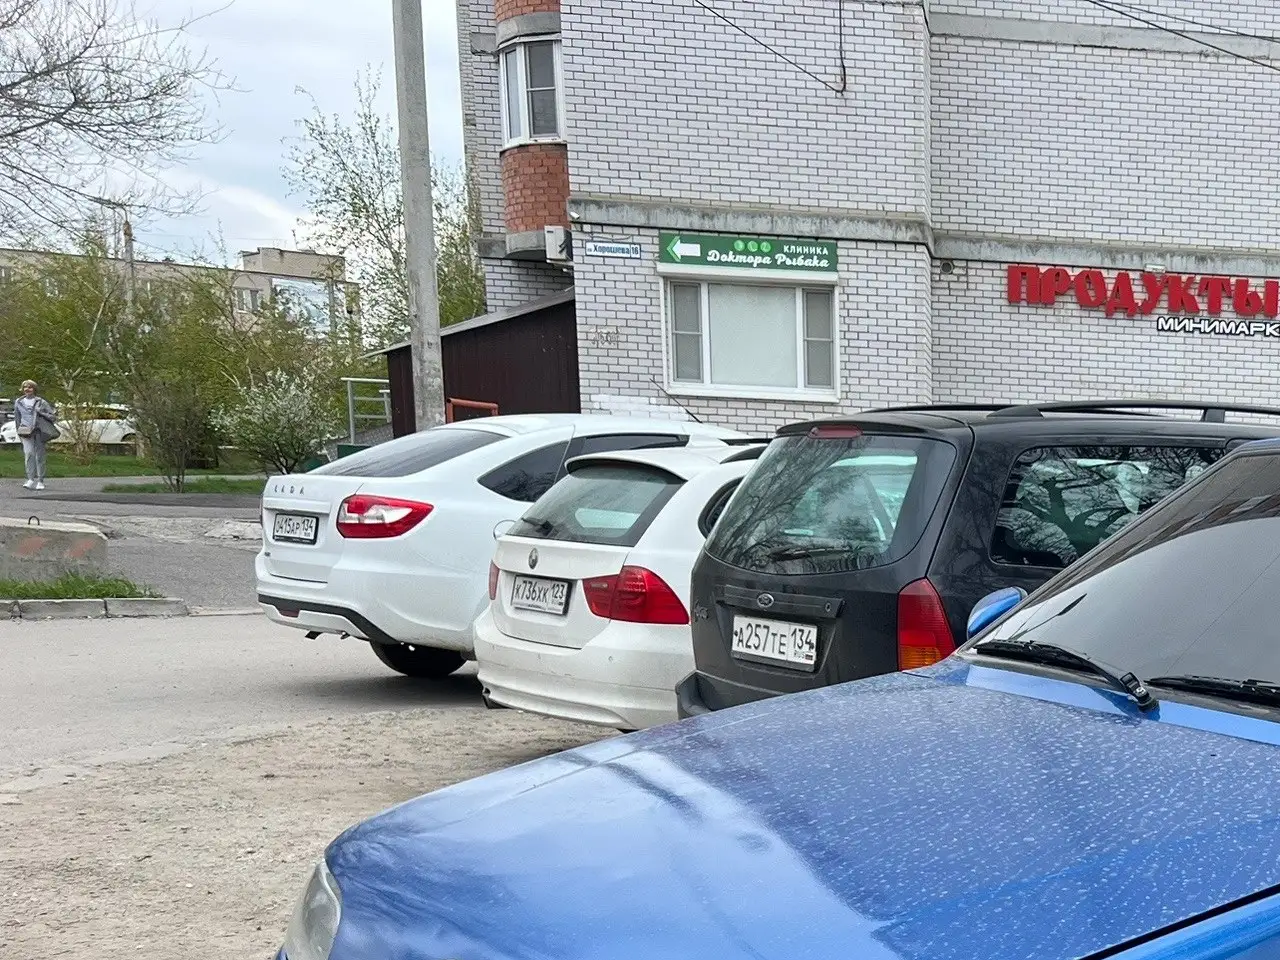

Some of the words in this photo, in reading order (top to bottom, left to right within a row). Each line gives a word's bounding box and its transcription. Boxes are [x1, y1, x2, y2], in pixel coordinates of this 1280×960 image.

[593, 244, 630, 254] Хорошева
[783, 244, 829, 256] КЛИНИКА
[707, 249, 773, 267] Доктора
[774, 252, 830, 268] Рыбака
[1007, 265, 1280, 318] ПРОДУКТЫ
